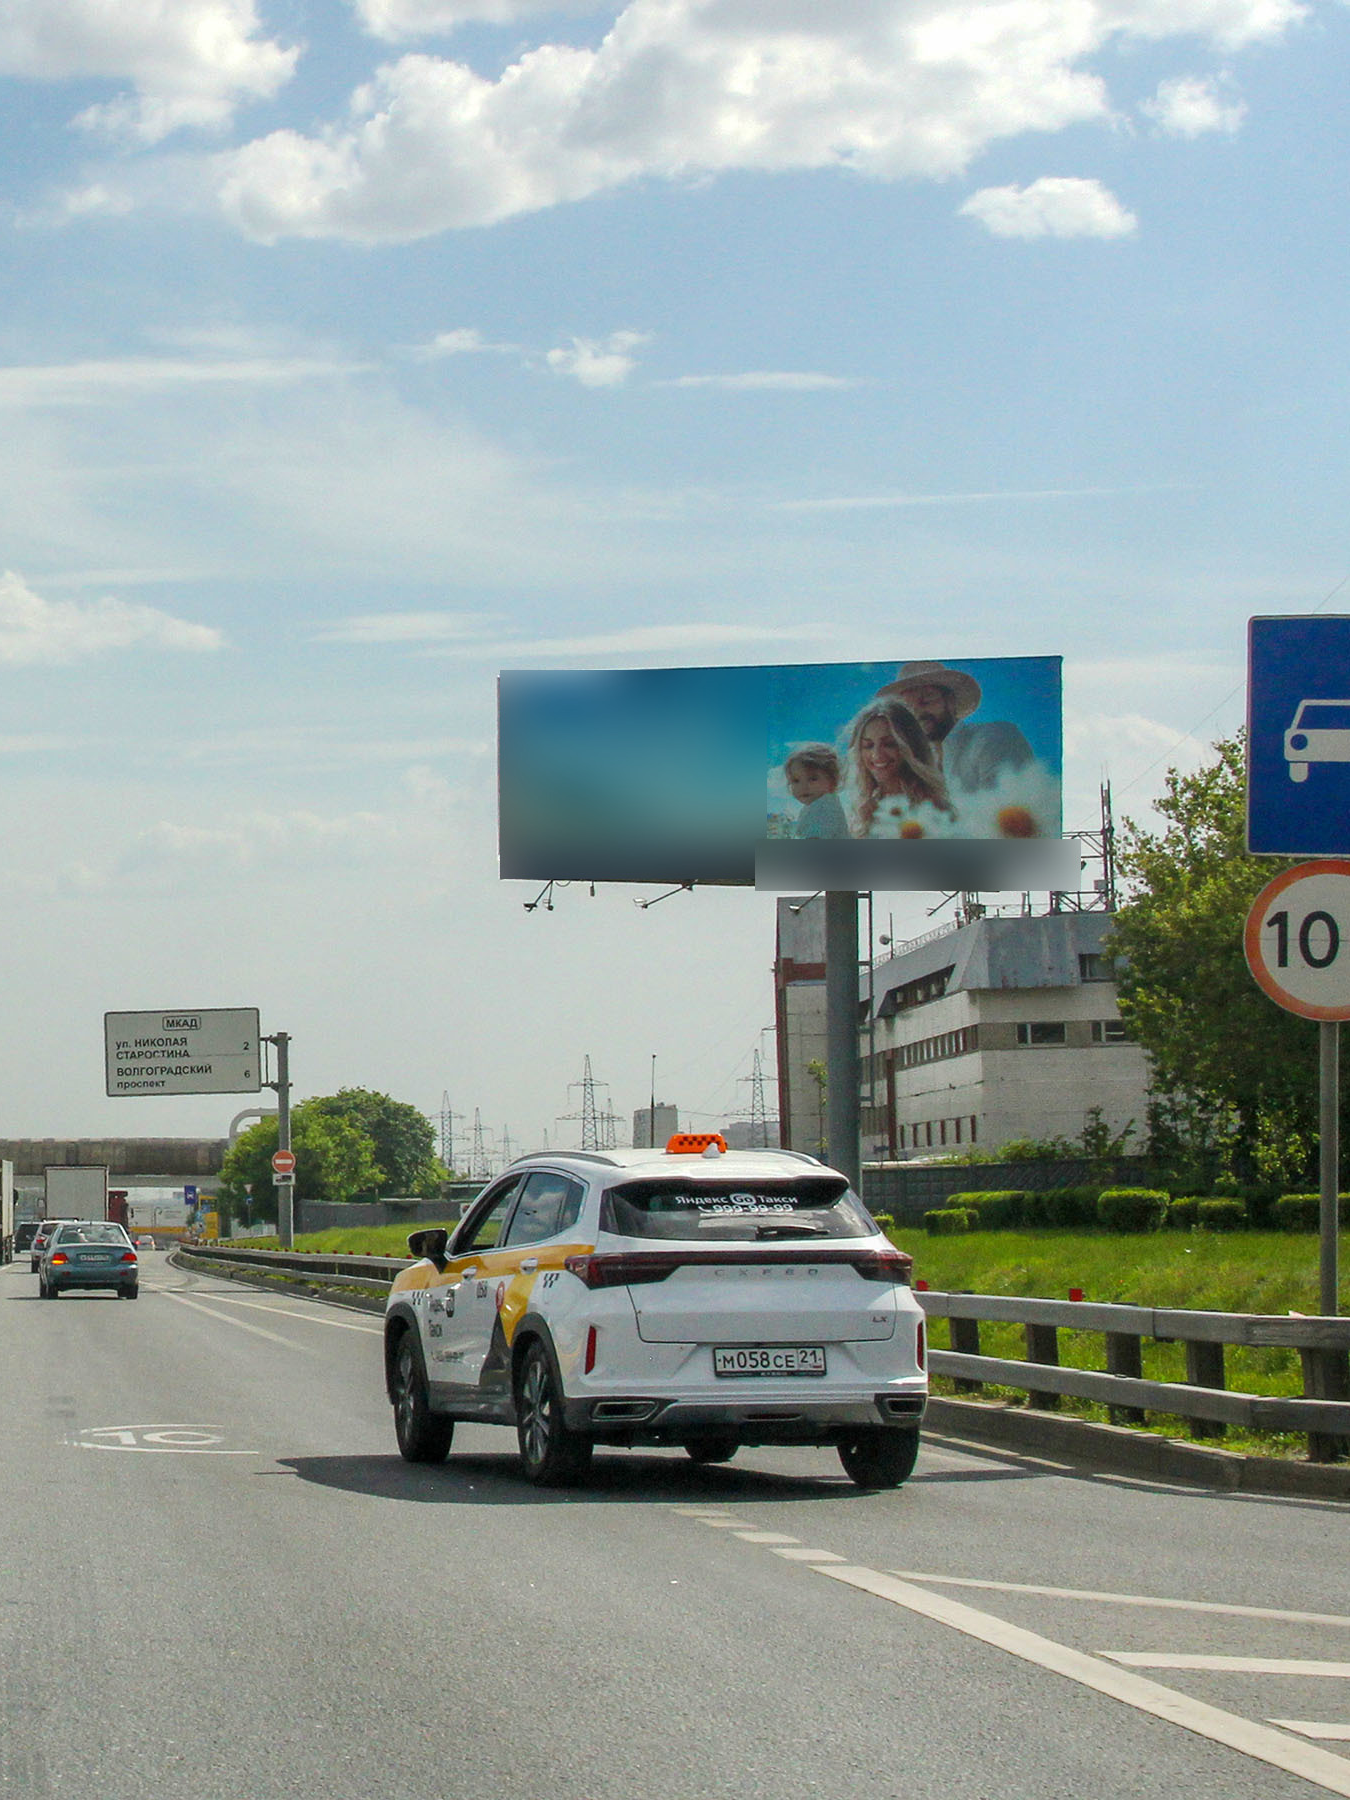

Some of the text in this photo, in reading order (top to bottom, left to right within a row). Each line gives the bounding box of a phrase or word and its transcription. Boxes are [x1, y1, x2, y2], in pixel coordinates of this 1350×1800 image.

[1266, 910, 1340, 969] 10
[165, 1018, 198, 1029] МКАД
[116, 1037, 249, 1050] ул. НИКОЛАЯ 2
[116, 1050, 190, 1060] СТАРОСТИНА
[117, 1064, 250, 1078] ВОЛГОГРАДСКИЙ 6
[117, 1080, 165, 1090] проспект
[675, 1196, 728, 1205] Яндекс
[757, 1195, 798, 1204] Такси
[713, 1204, 793, 1212] 999-99-99
[799, 1350, 818, 1363] 21
